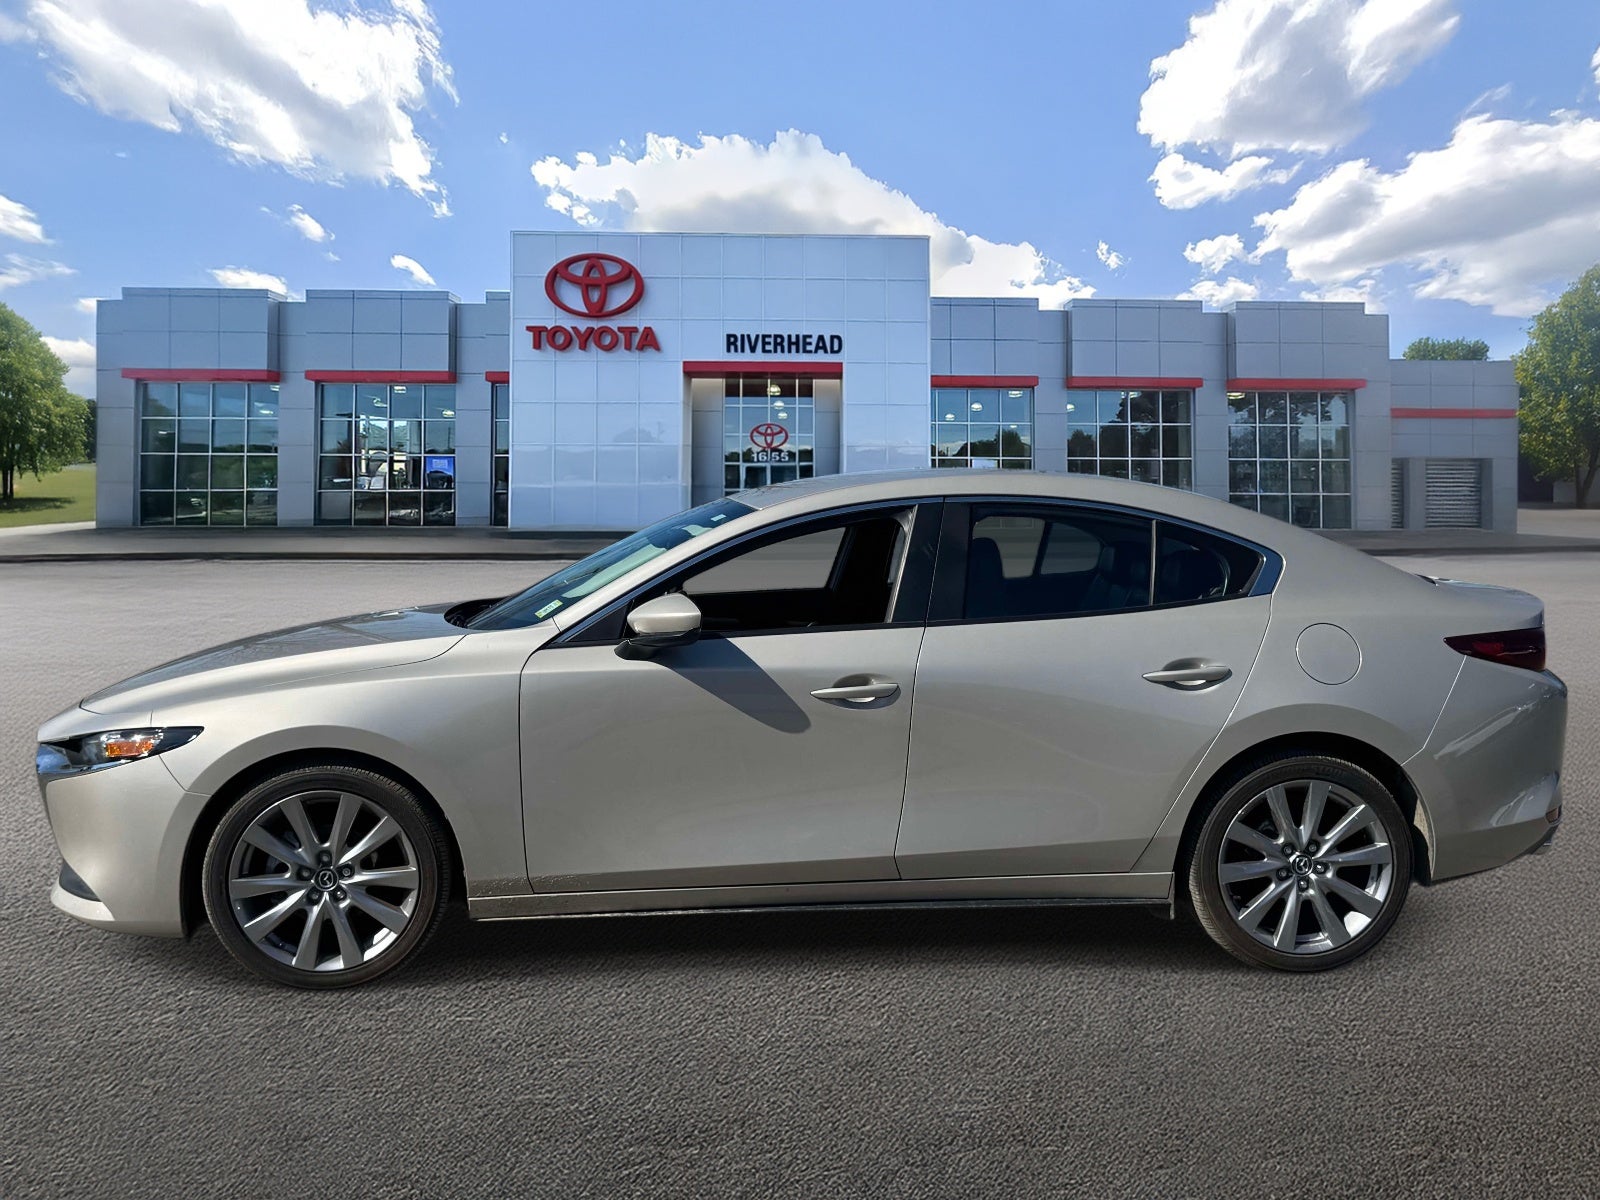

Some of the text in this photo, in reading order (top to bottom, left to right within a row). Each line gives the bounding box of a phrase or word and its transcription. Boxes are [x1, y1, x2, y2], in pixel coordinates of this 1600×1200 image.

[525, 325, 662, 352] TOYOTA
[726, 333, 843, 354] RIVERHEAD
[752, 451, 789, 462] 1655
